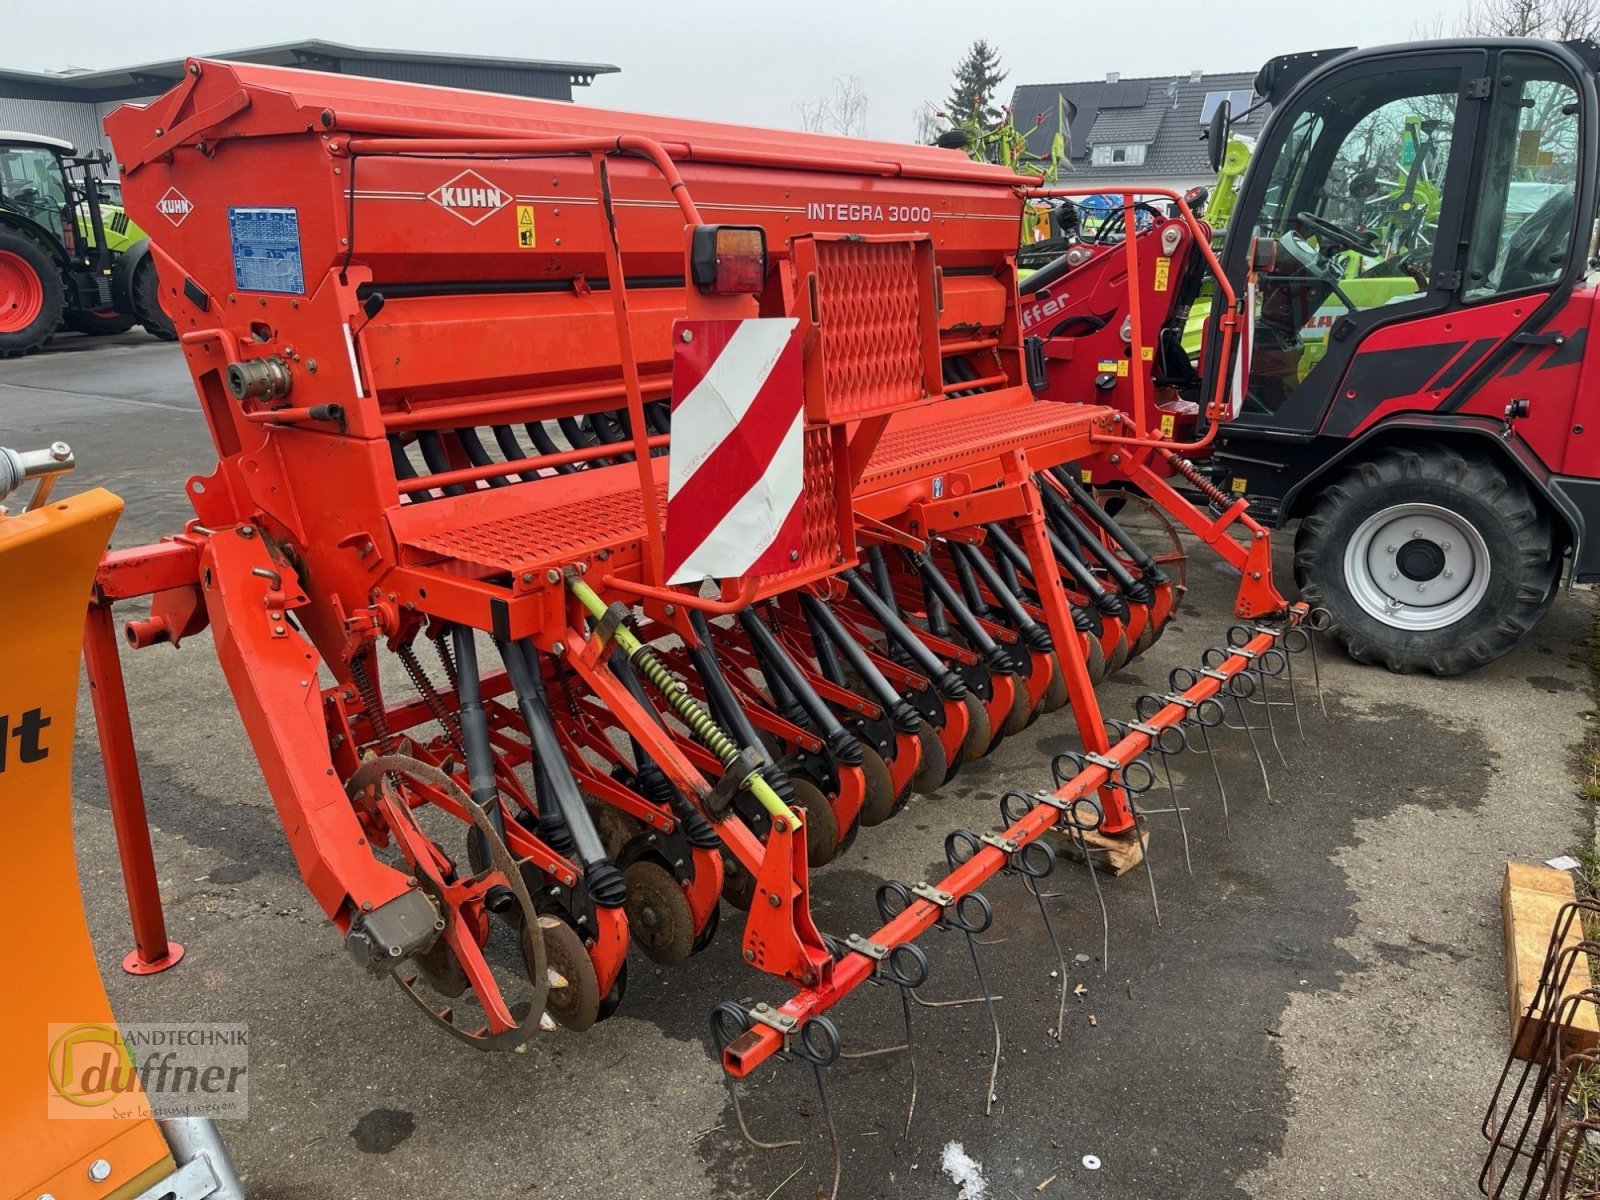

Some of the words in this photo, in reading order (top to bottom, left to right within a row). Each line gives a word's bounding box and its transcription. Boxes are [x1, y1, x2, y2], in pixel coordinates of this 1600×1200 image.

[161, 199, 189, 214] KUHN
[441, 187, 501, 207] KUHN
[807, 202, 884, 221] INTEGRA
[887, 206, 931, 222] 3000
[1022, 293, 1070, 329] ffer
